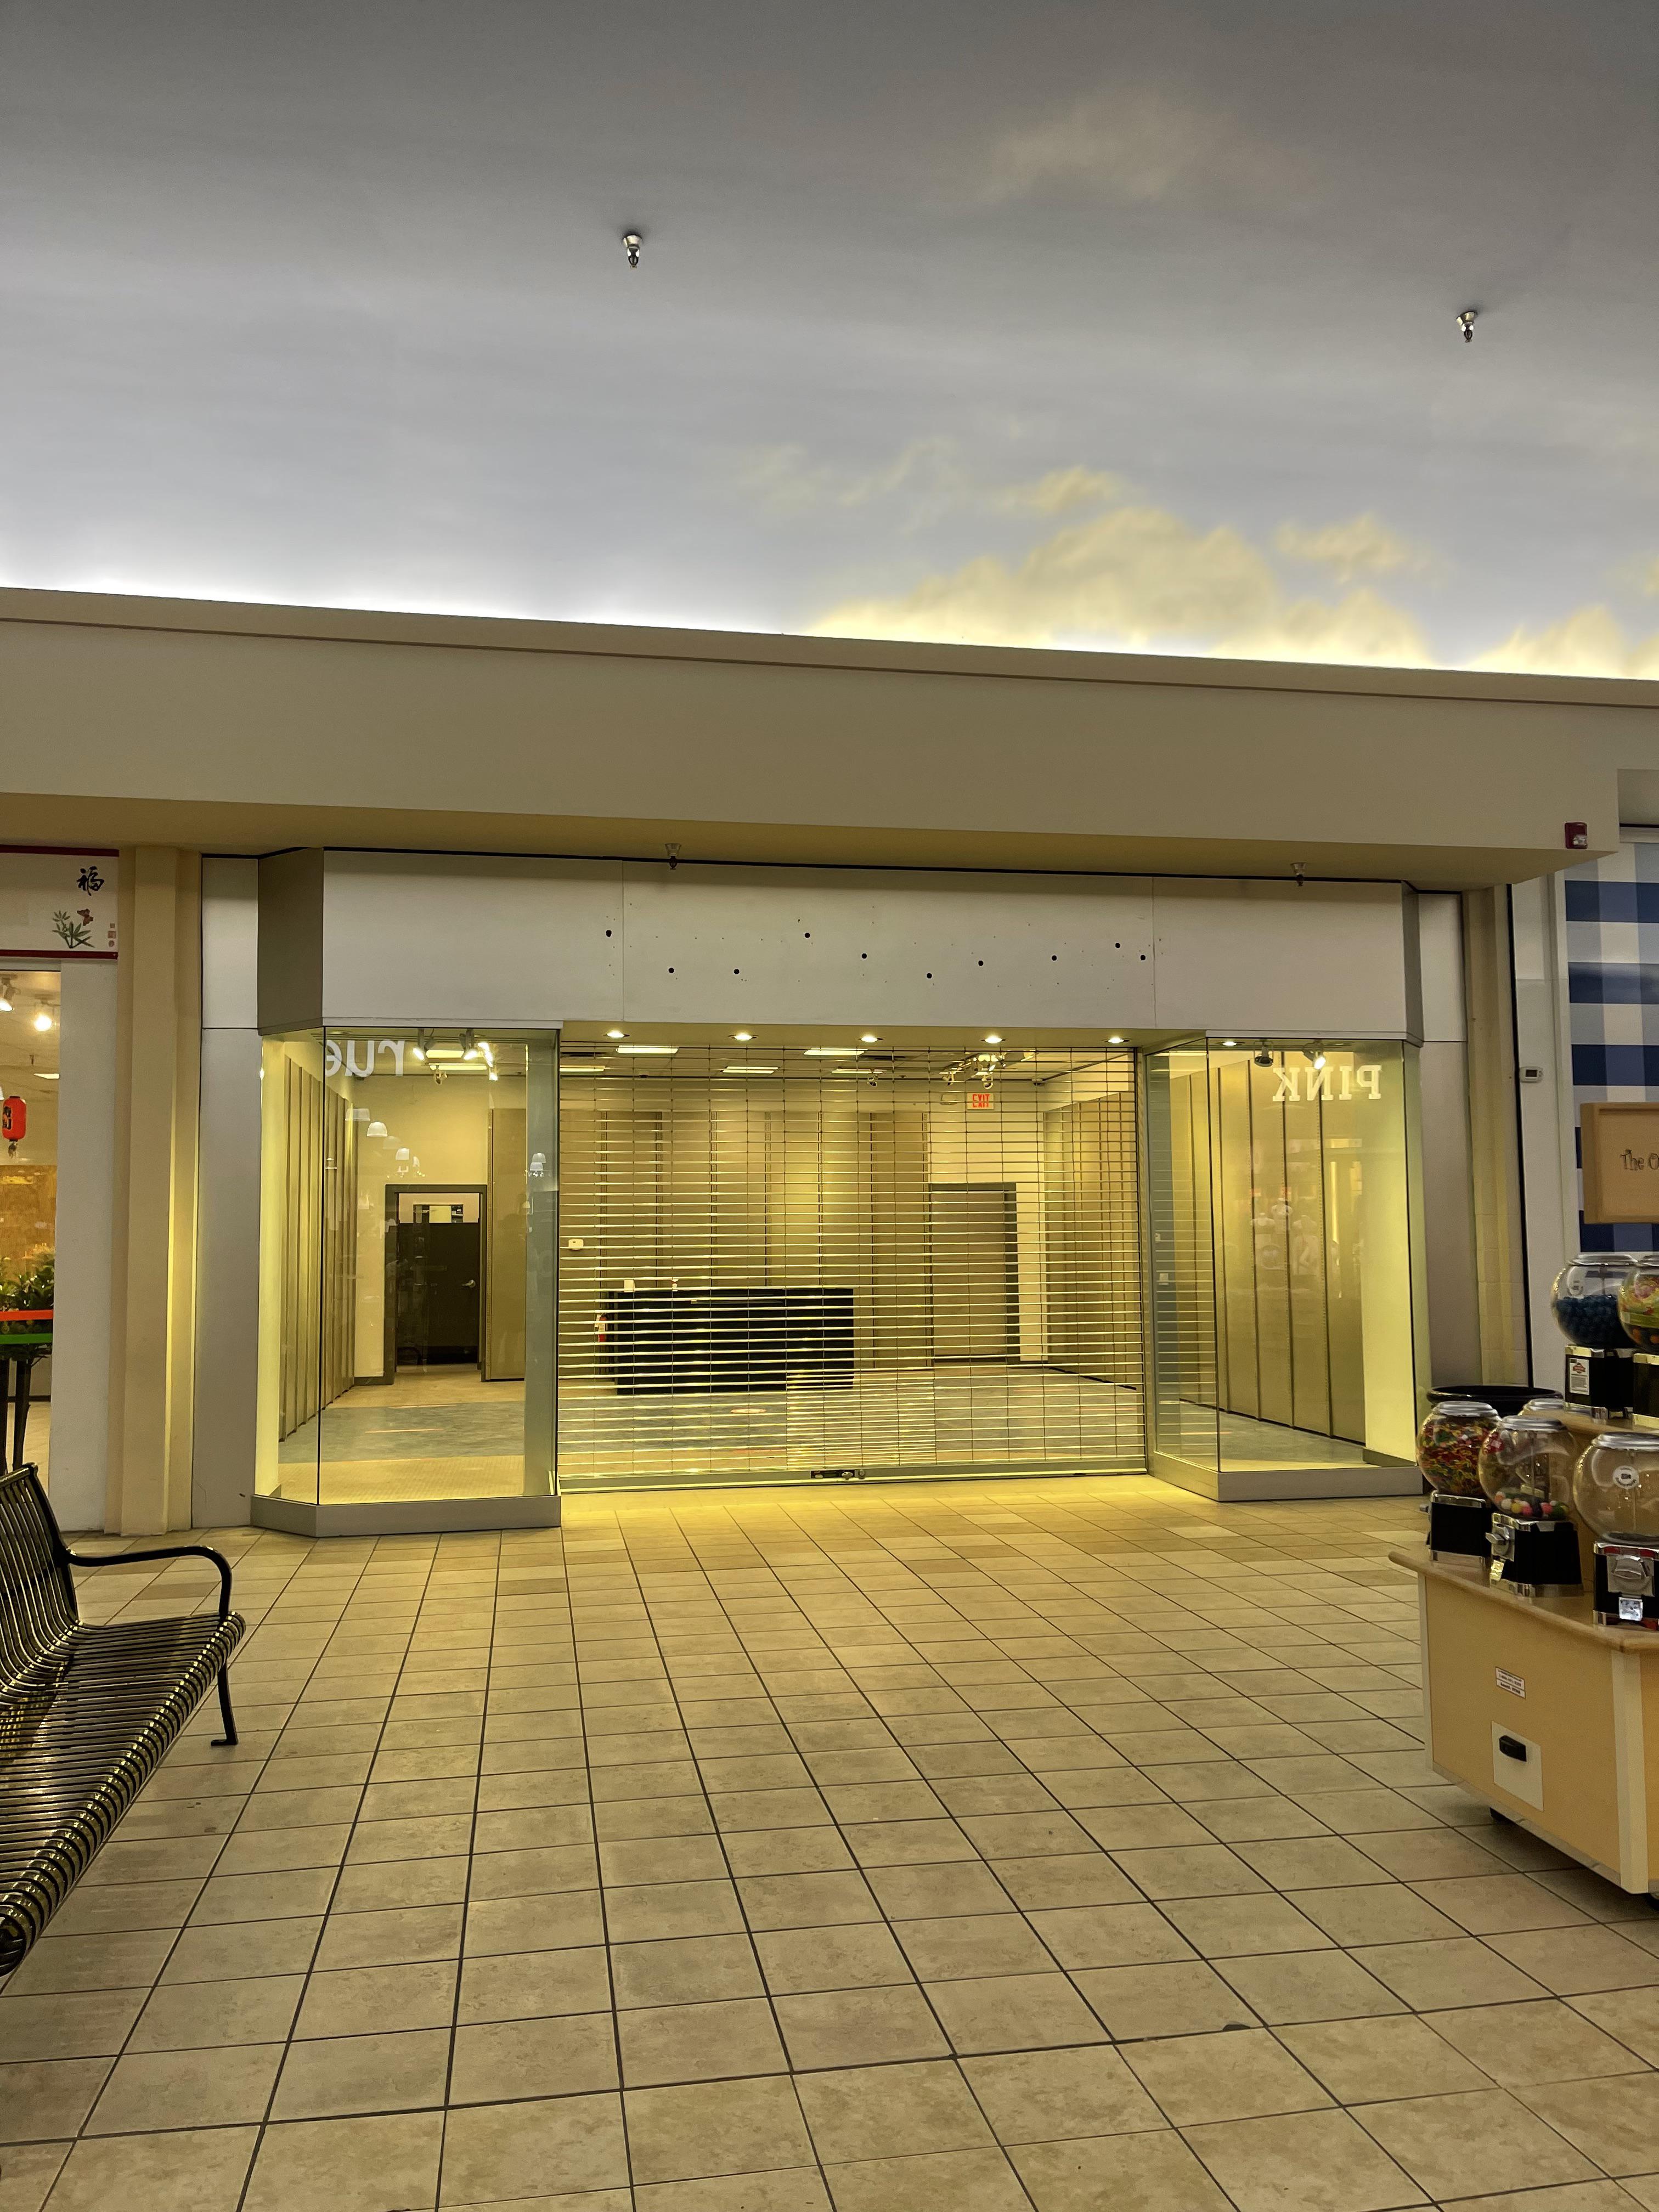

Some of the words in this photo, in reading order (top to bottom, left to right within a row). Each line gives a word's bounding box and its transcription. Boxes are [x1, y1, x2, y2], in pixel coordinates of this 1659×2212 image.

[77, 866, 105, 896] 福
[972, 1093, 990, 1108] EXIT
[1620, 1149, 1644, 1171] The
